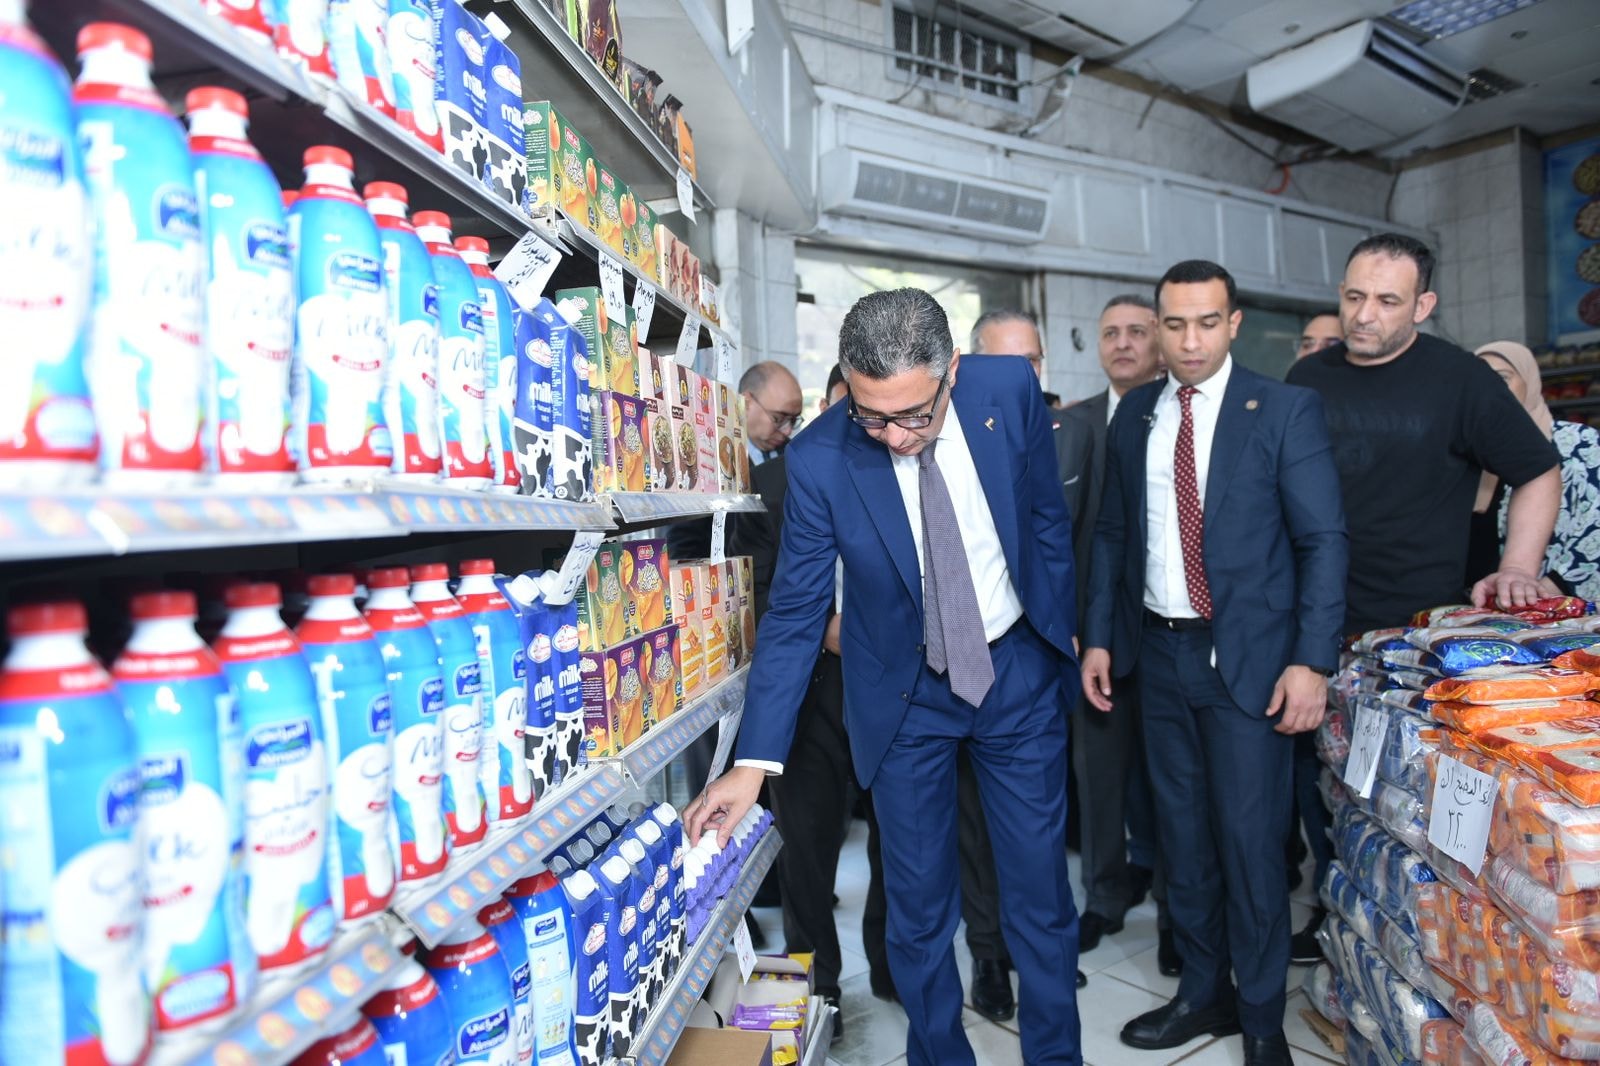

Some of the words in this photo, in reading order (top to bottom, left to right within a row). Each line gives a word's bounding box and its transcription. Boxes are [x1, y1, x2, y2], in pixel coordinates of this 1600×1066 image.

[534, 675, 554, 702] milk
[558, 664, 581, 689] milk
[588, 959, 609, 993] milk
